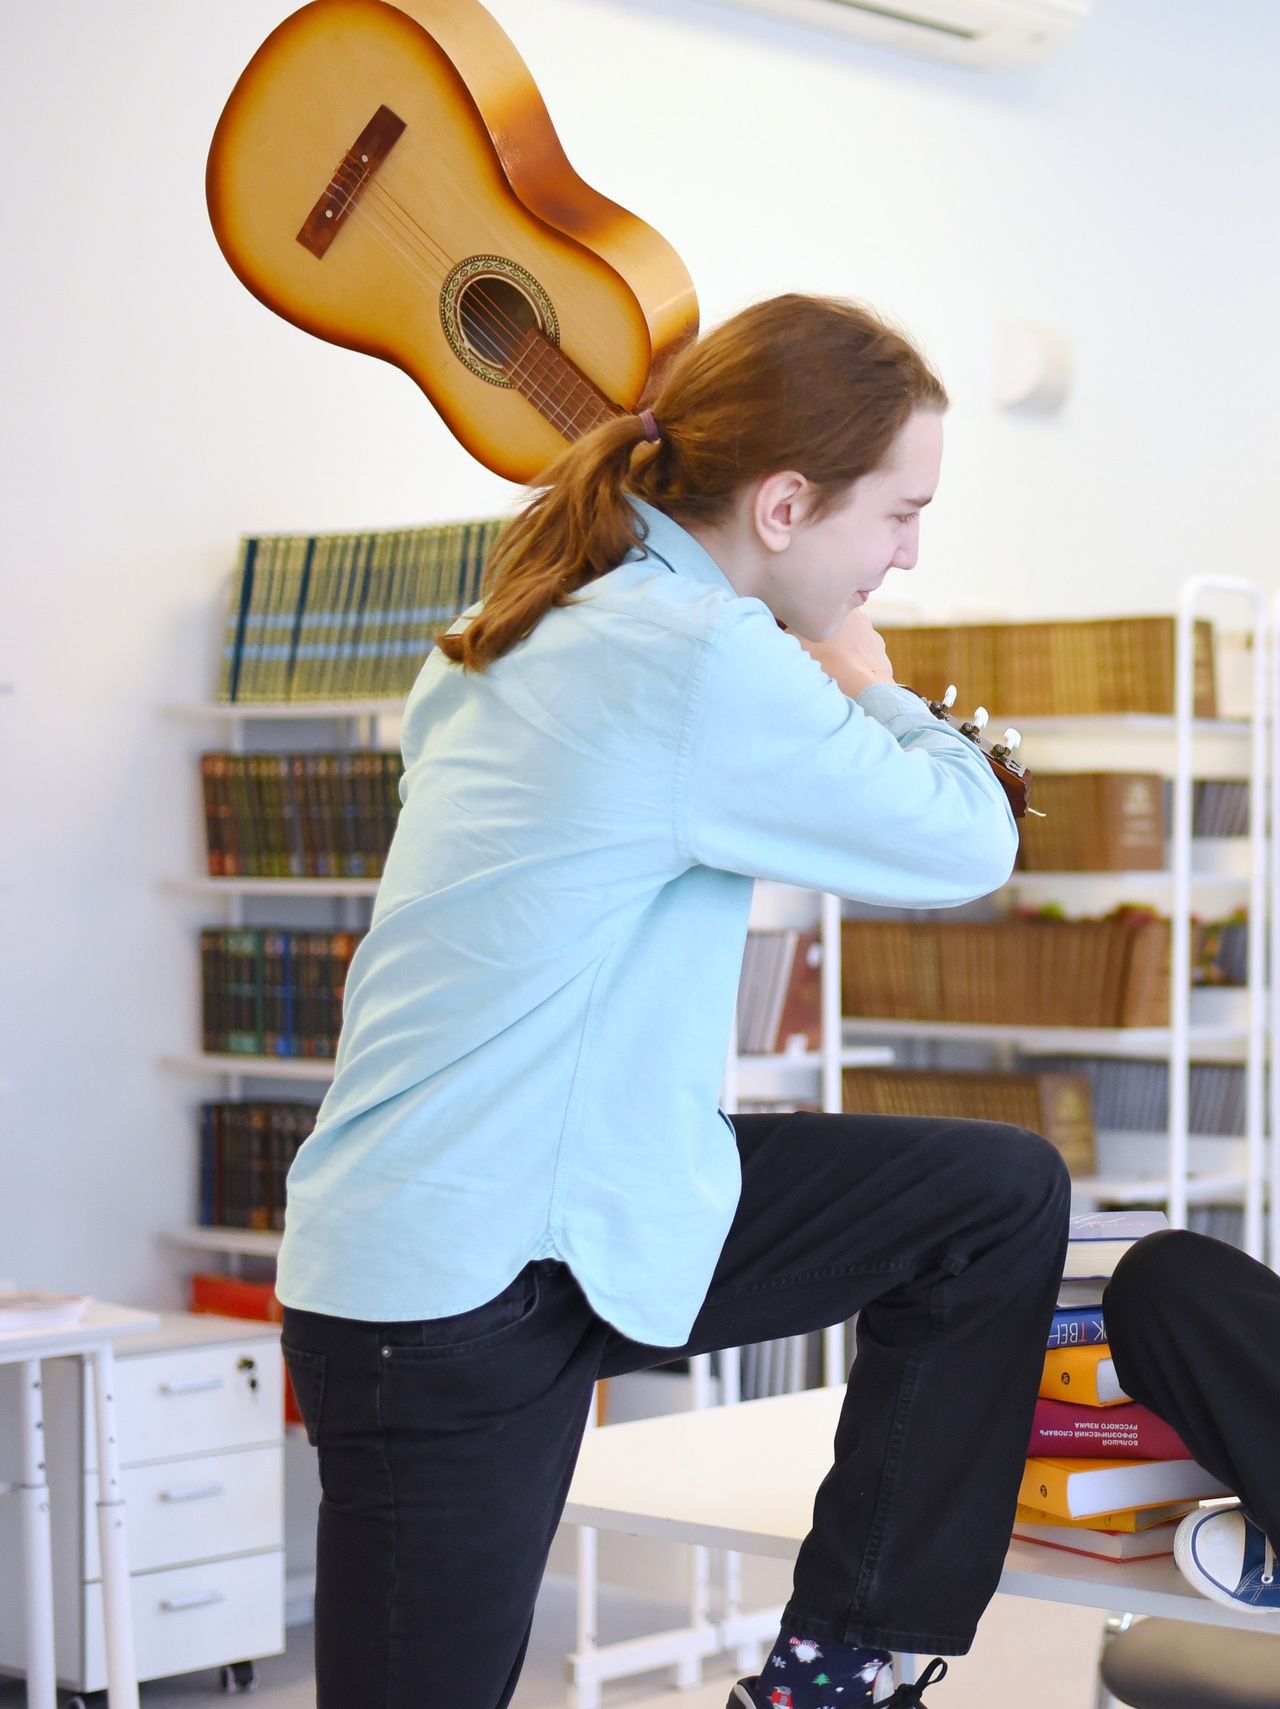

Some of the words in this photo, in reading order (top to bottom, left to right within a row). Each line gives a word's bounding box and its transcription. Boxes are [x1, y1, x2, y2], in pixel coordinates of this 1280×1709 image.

[1100, 1422, 1138, 1430] РУССКОГО
[1039, 1429, 1073, 1437] СЛОВАРЬ
[1074, 1431, 1138, 1439] ОРФОЭПИЧЕСКИЙ
